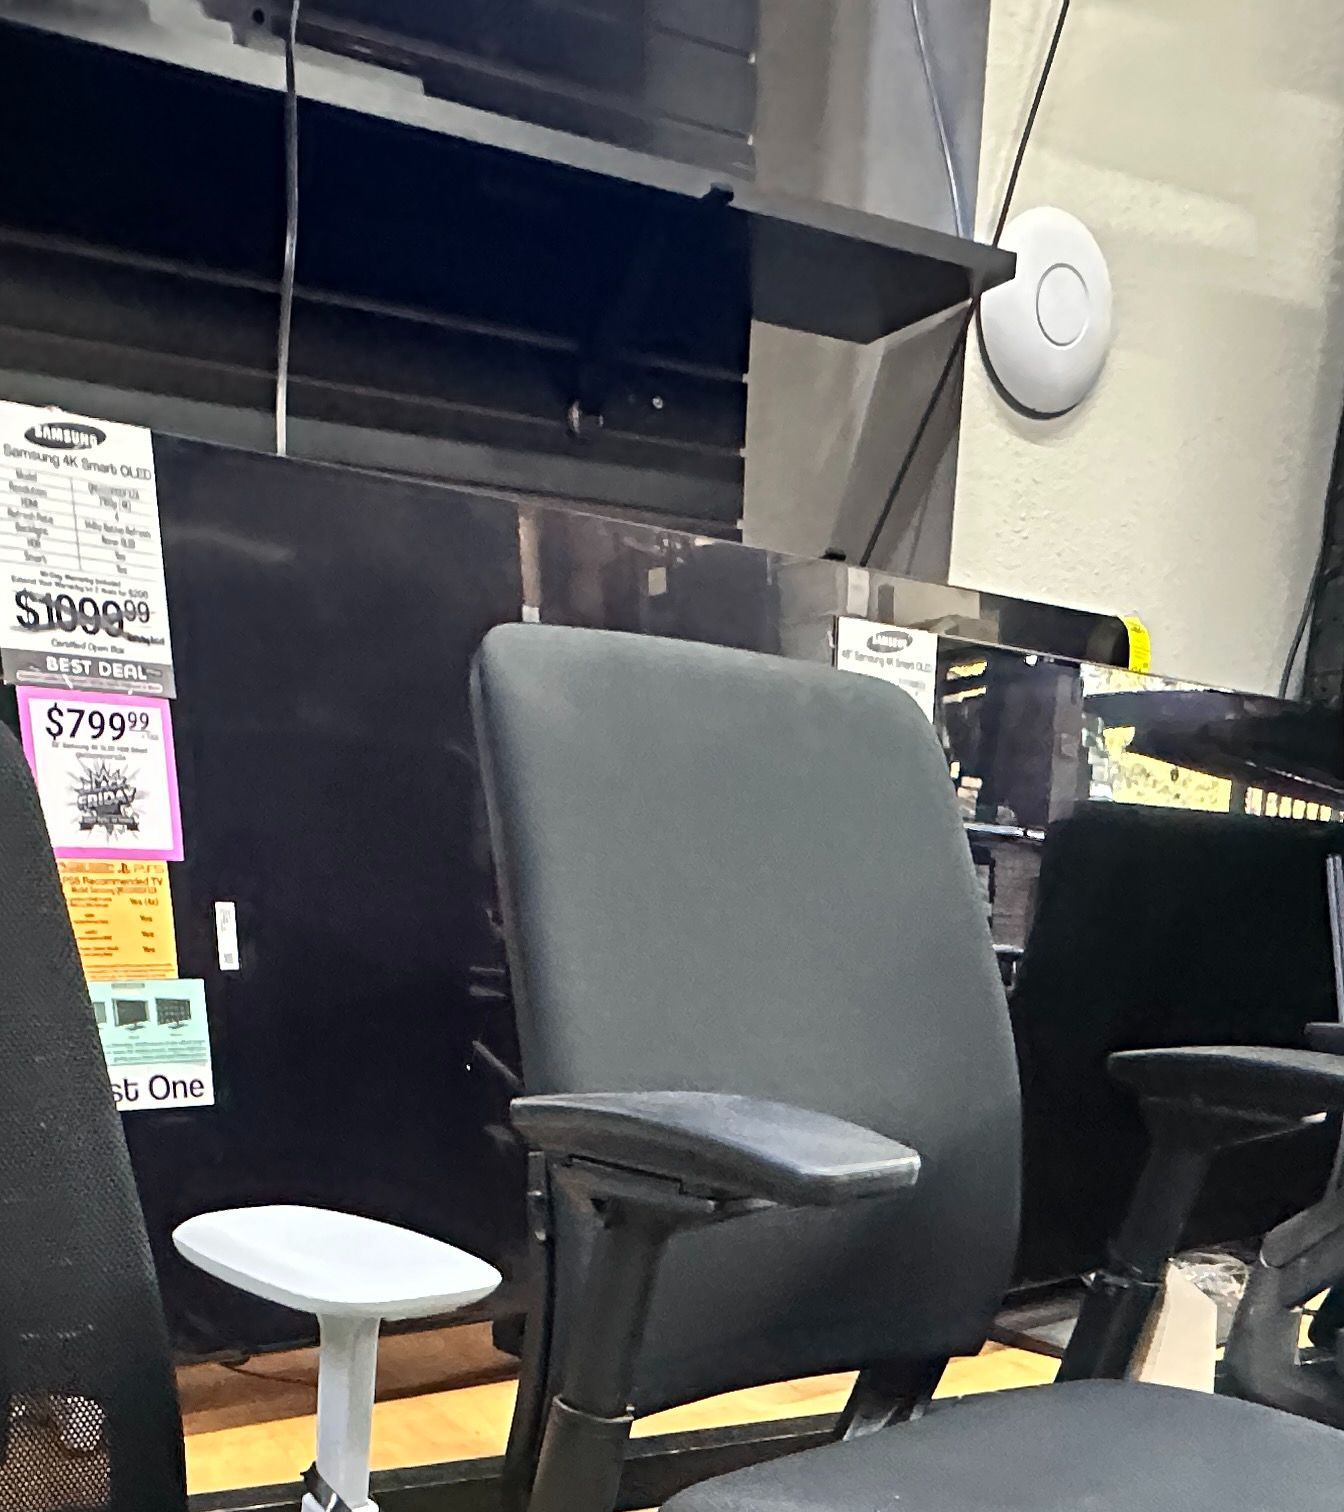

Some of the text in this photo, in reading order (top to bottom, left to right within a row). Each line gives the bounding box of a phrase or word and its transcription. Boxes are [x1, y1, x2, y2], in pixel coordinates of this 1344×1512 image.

[4, 443, 59, 468] Samsung
[63, 455, 78, 468] 4K
[46, 656, 92, 675] BEST
[98, 661, 147, 680] DEAL
[46, 702, 125, 741] $799
[151, 877, 163, 886] TV
[111, 1074, 205, 1102] st One
